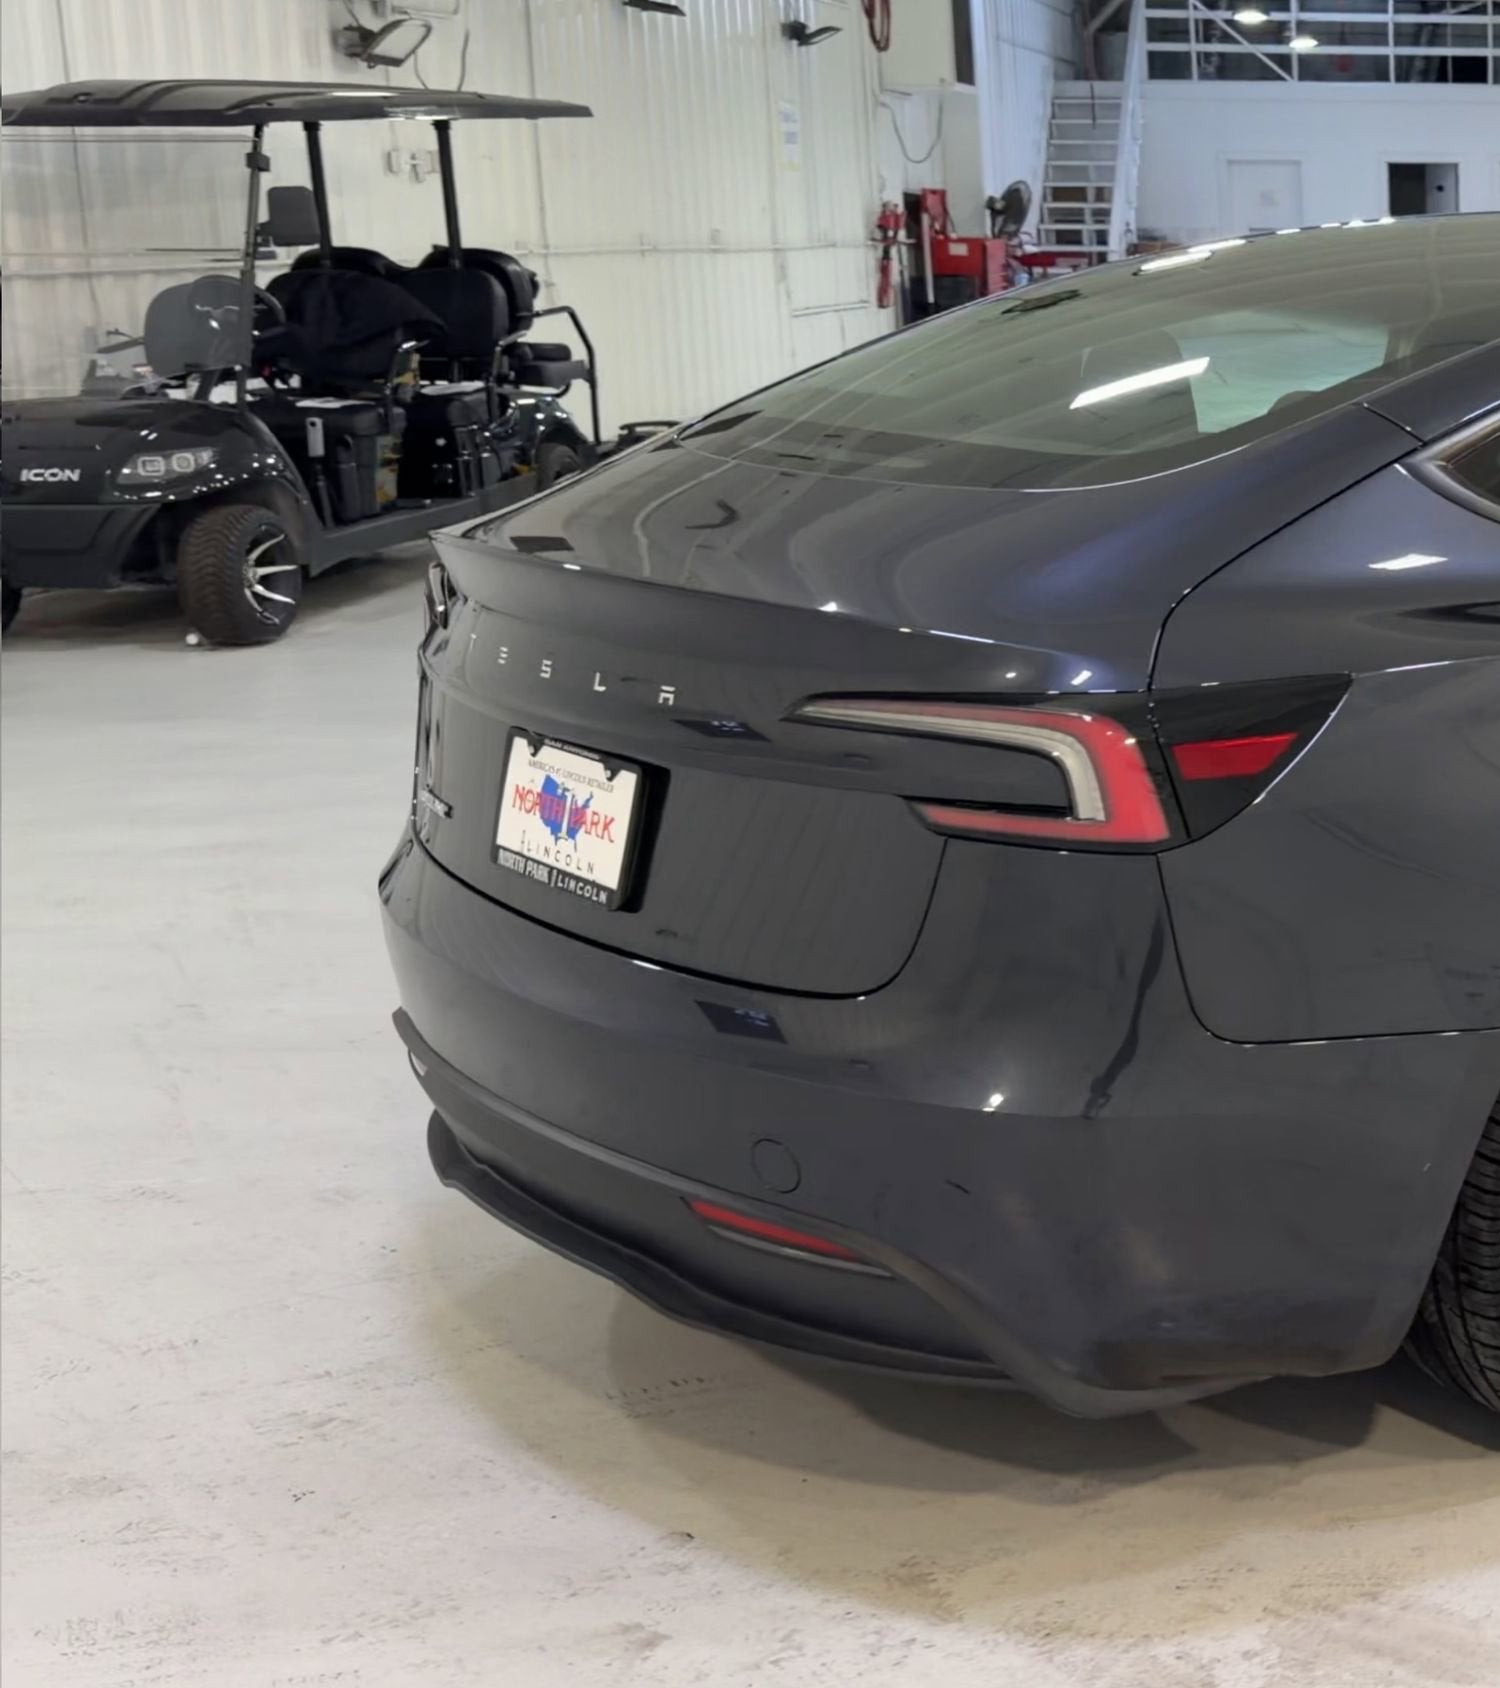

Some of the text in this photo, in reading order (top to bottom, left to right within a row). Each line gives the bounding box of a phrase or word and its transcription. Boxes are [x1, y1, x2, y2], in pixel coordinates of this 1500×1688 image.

[20, 468, 80, 481] ICON
[469, 633, 675, 706] TESLA
[511, 783, 615, 843] NORTH PARK
[497, 848, 608, 904] NORTH PARK LINCOLN
[527, 840, 595, 874] LINCOLN
